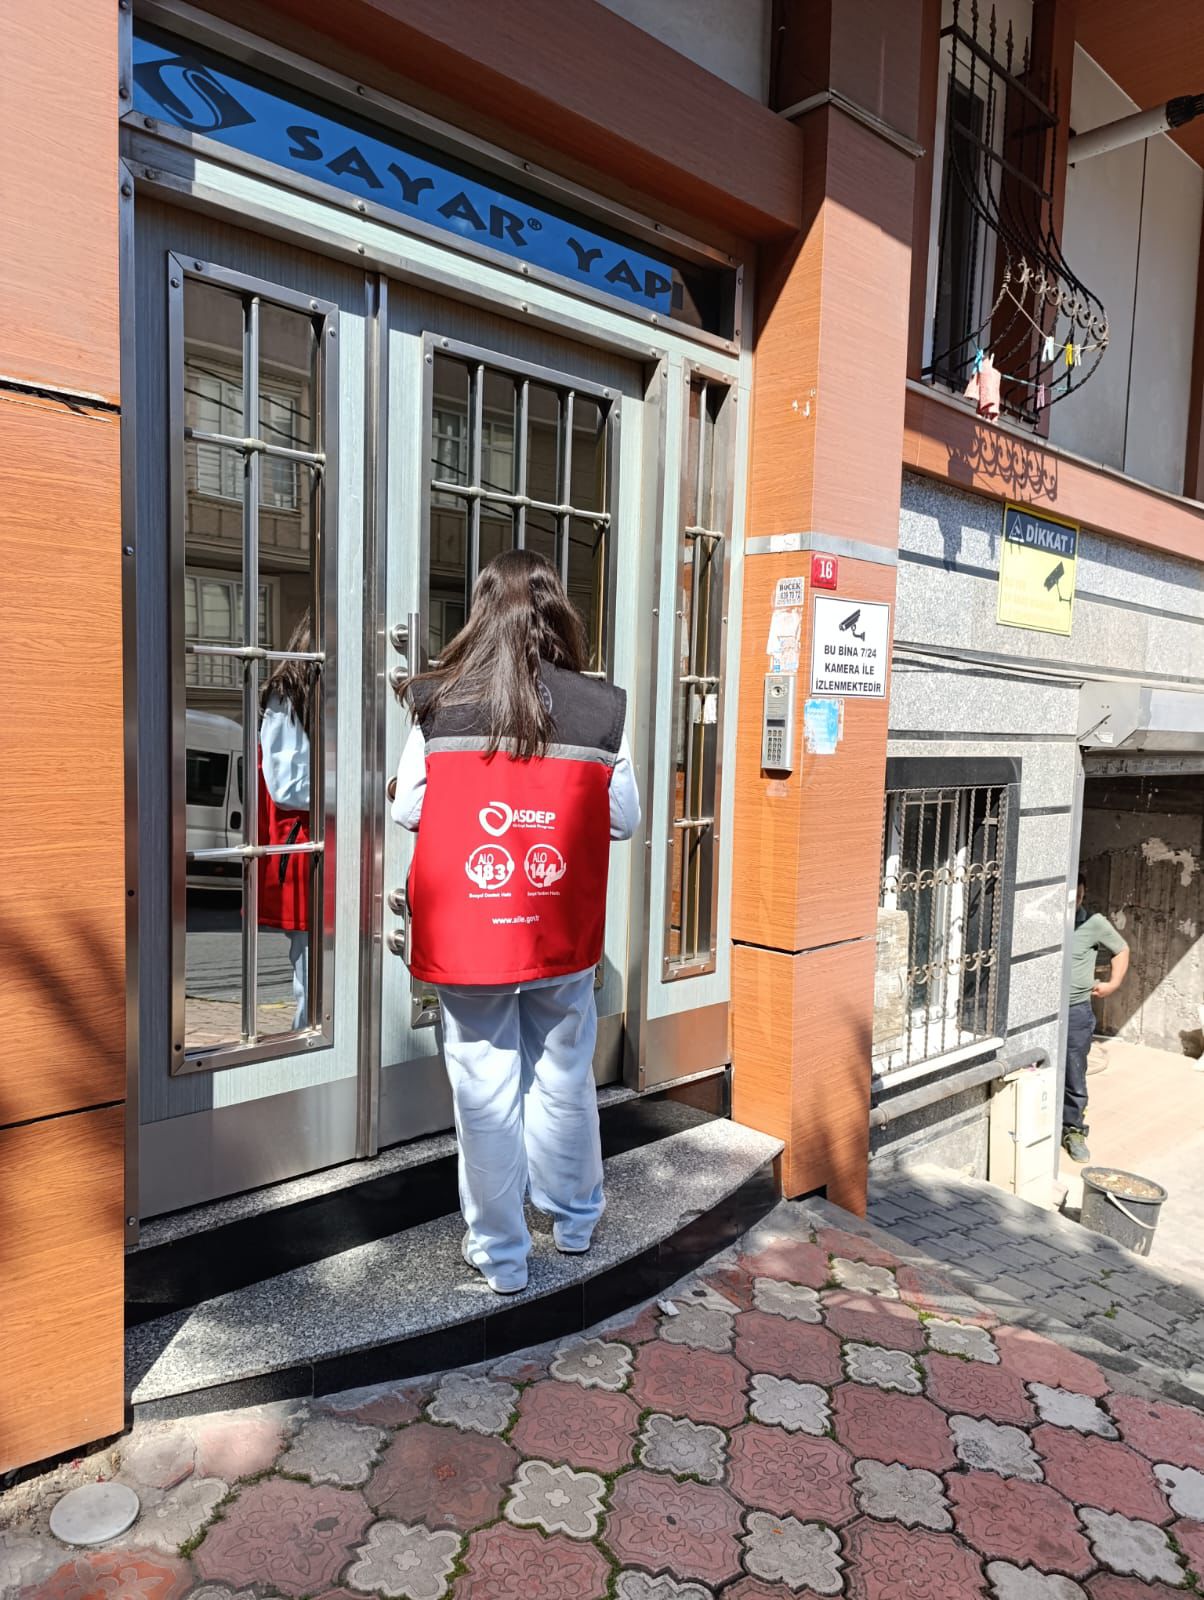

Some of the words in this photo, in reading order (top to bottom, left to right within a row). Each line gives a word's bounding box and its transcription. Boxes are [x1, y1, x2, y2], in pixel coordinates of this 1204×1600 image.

[566, 236, 684, 310] YAPI
[1025, 523, 1069, 553] DİKKAT
[824, 644, 836, 656] BU
[838, 644, 858, 657] BİNA
[860, 647, 877, 659] 7/24
[824, 662, 860, 675] KAMERA
[862, 663, 875, 675] İLE
[815, 677, 882, 693] İZLENMEKTEDİR
[512, 809, 556, 824] ASDEP
[478, 853, 494, 865] ALO
[532, 852, 548, 863] ALO
[474, 863, 506, 881] 183
